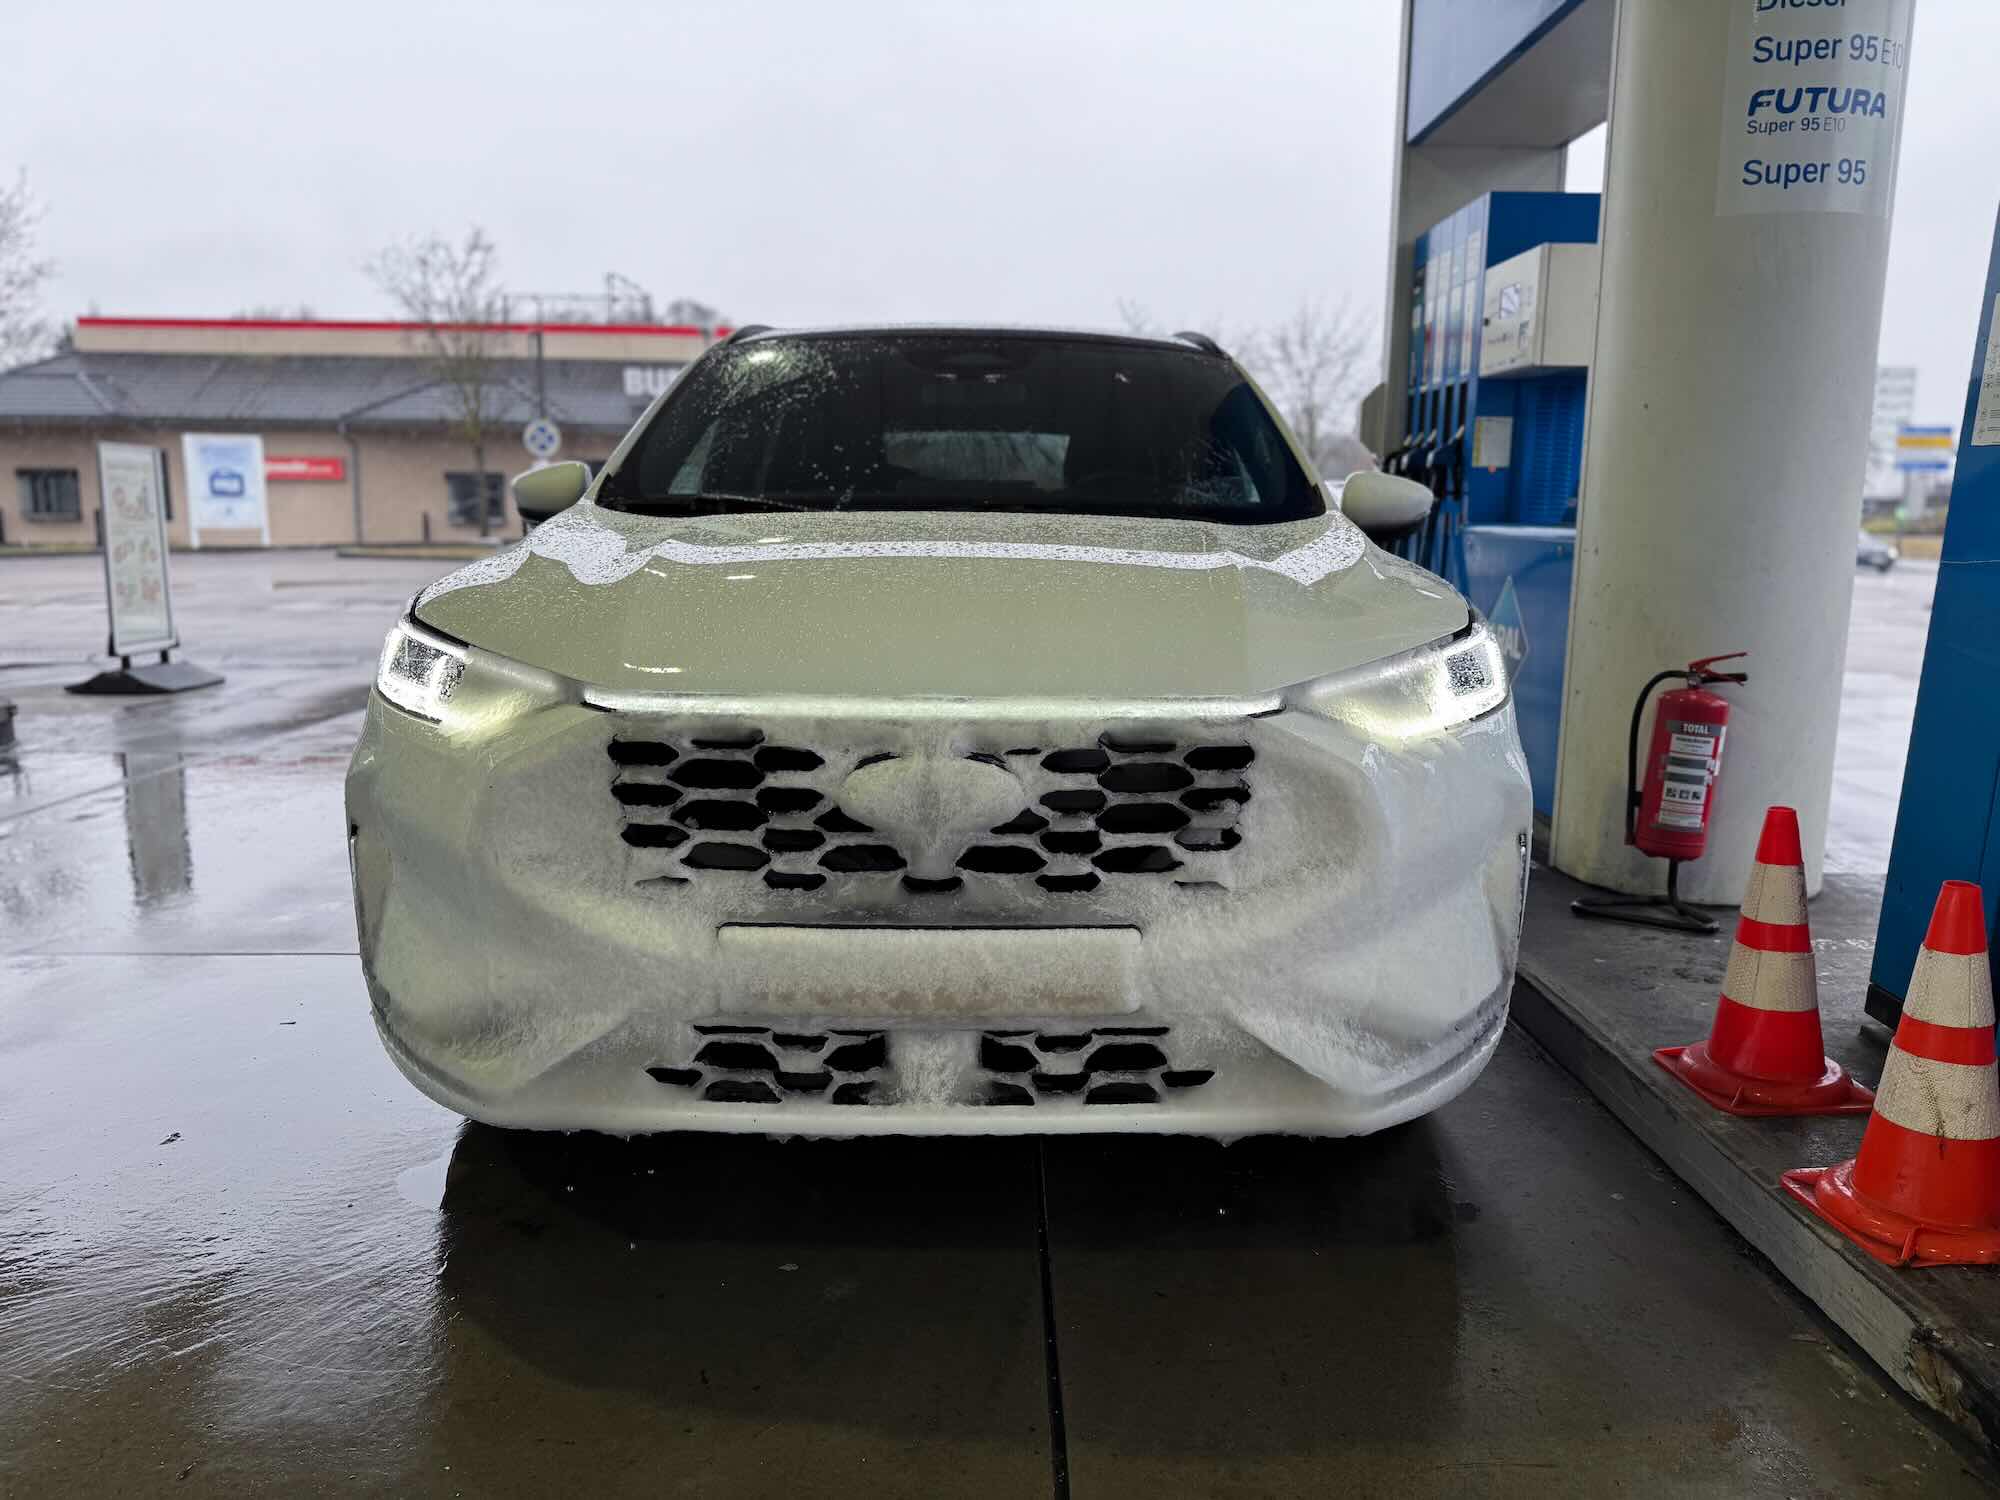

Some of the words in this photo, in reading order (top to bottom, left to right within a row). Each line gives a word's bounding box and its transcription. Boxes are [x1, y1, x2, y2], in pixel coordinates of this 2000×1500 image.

[1752, 36, 1842, 66] Super
[1850, 33, 1878, 62] 95
[1881, 38, 1904, 72] E10
[1747, 87, 1886, 119] FUTURA
[1746, 119, 1796, 136] Super
[1800, 117, 1820, 132] 95
[1823, 116, 1846, 133] E10
[1742, 159, 1830, 190] Super
[1838, 158, 1866, 185] 95
[1683, 723, 1710, 735] TOTAL
